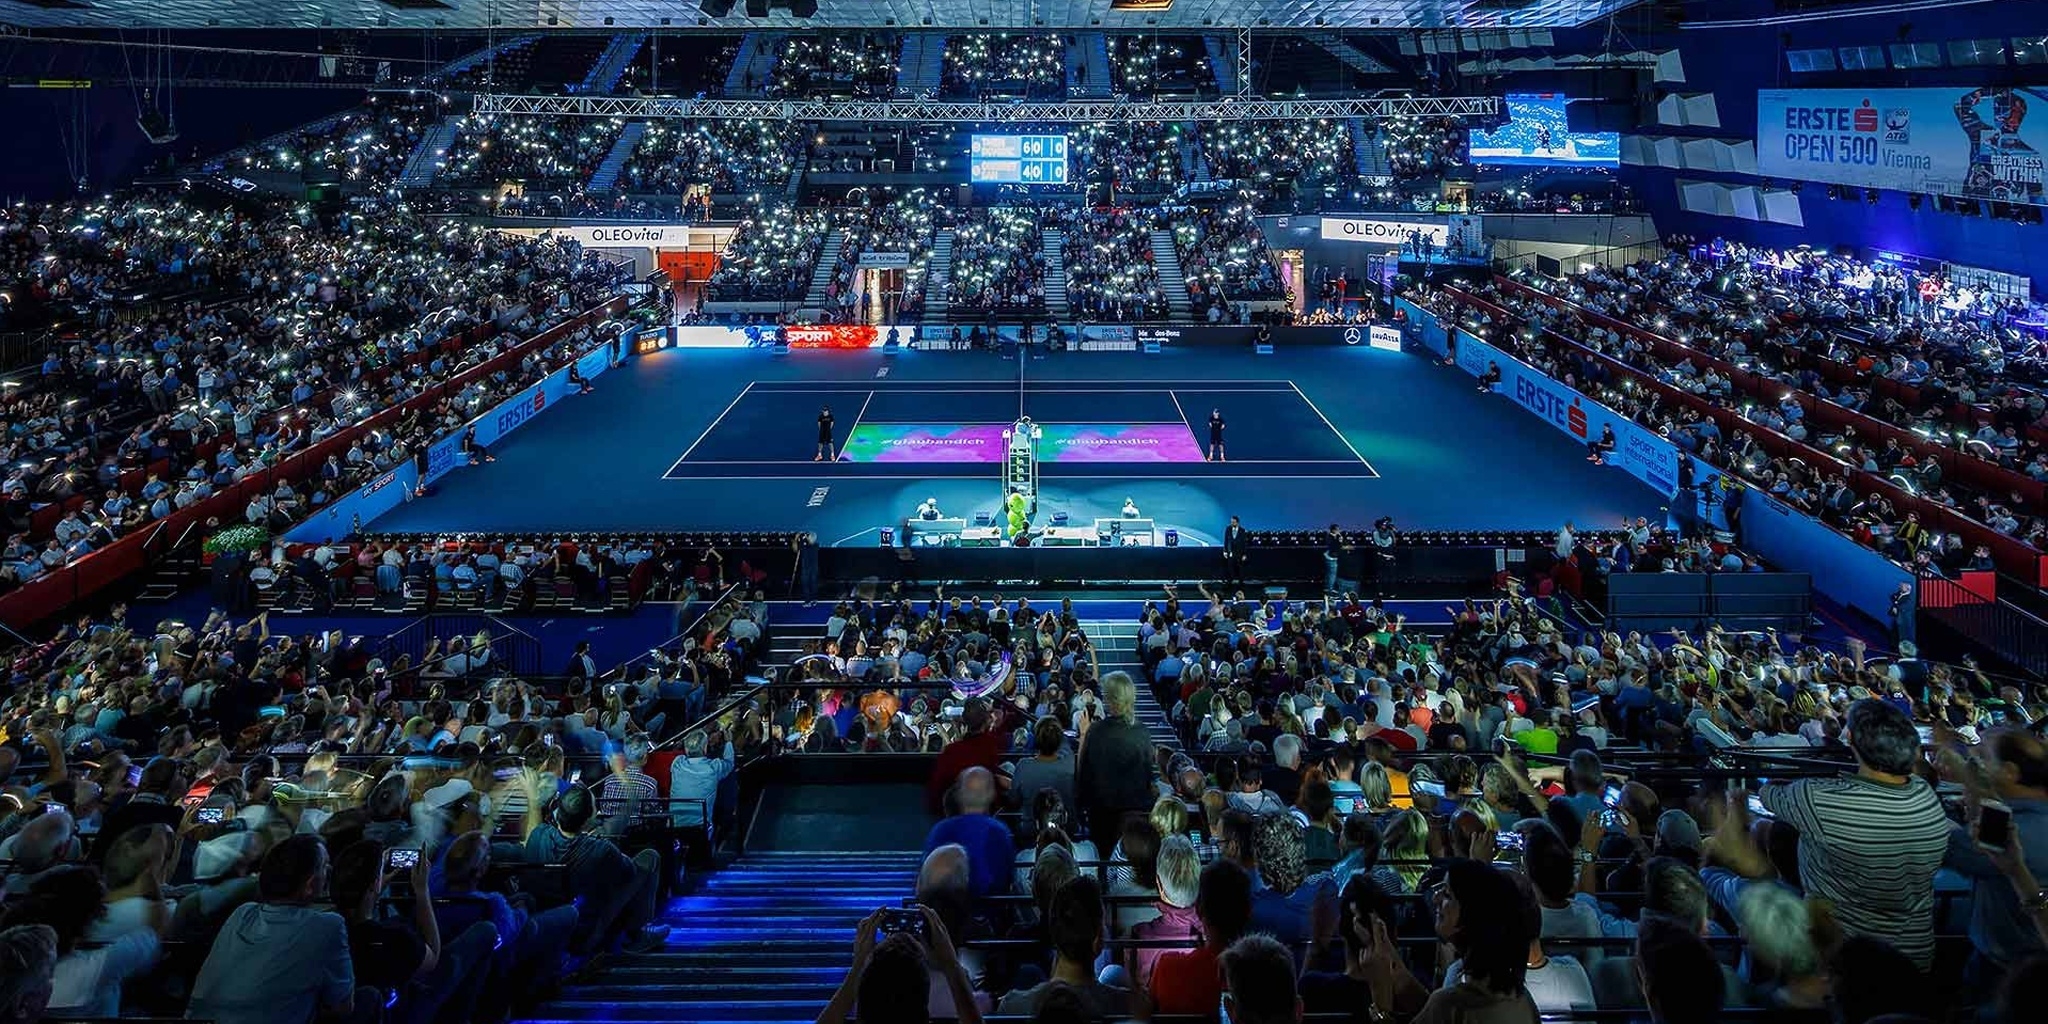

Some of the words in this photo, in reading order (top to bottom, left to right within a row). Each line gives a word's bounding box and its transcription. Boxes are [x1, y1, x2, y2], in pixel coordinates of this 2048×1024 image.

[1785, 106, 1851, 131] ERSTE
[1885, 132, 1908, 141] ATP
[1785, 132, 1834, 163] OPEN
[1840, 135, 1878, 166] 500
[1882, 148, 1931, 170] Vienna
[1991, 154, 2042, 168] GREATNESS
[1992, 165, 2043, 183] WITHIN
[592, 228, 664, 241] OLEOvital
[787, 331, 833, 342] SPORT
[1516, 374, 1565, 426] ERSTE
[497, 398, 533, 435] ERSTE
[880, 437, 985, 446] #glaubandich
[1056, 437, 1159, 446] #glaubandich
[1629, 435, 1656, 455] SPORT
[374, 472, 395, 491] SPORT
